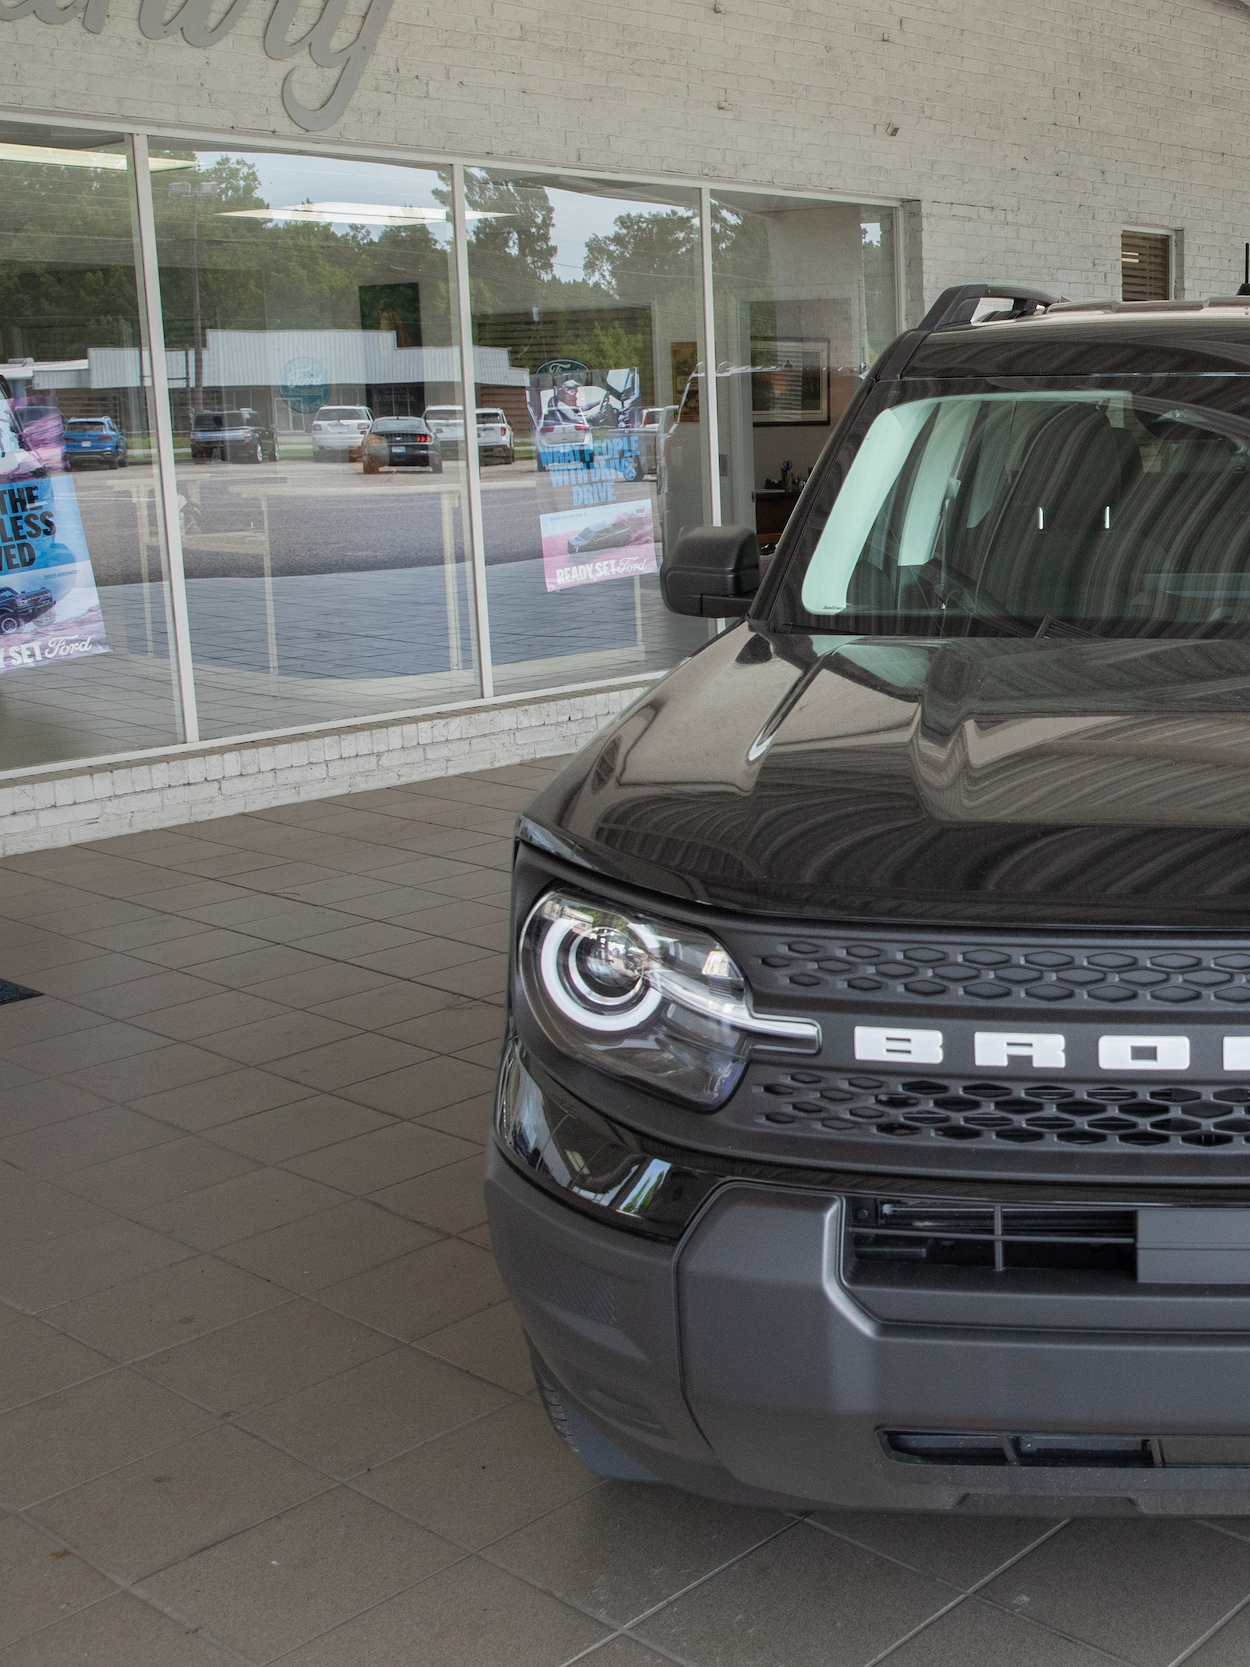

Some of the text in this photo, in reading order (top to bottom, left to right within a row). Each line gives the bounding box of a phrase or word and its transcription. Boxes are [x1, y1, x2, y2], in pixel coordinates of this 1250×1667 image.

[287, 366, 323, 389] Ford
[539, 435, 639, 467] WHAT PEOPLE
[549, 457, 635, 487] WITH DRIVE
[0, 485, 43, 515] THE
[571, 481, 616, 506] DRIVE
[0, 542, 36, 571] ED
[556, 556, 648, 584] READY SET Ford
[9, 641, 43, 666] SET
[45, 635, 92, 658] Ford
